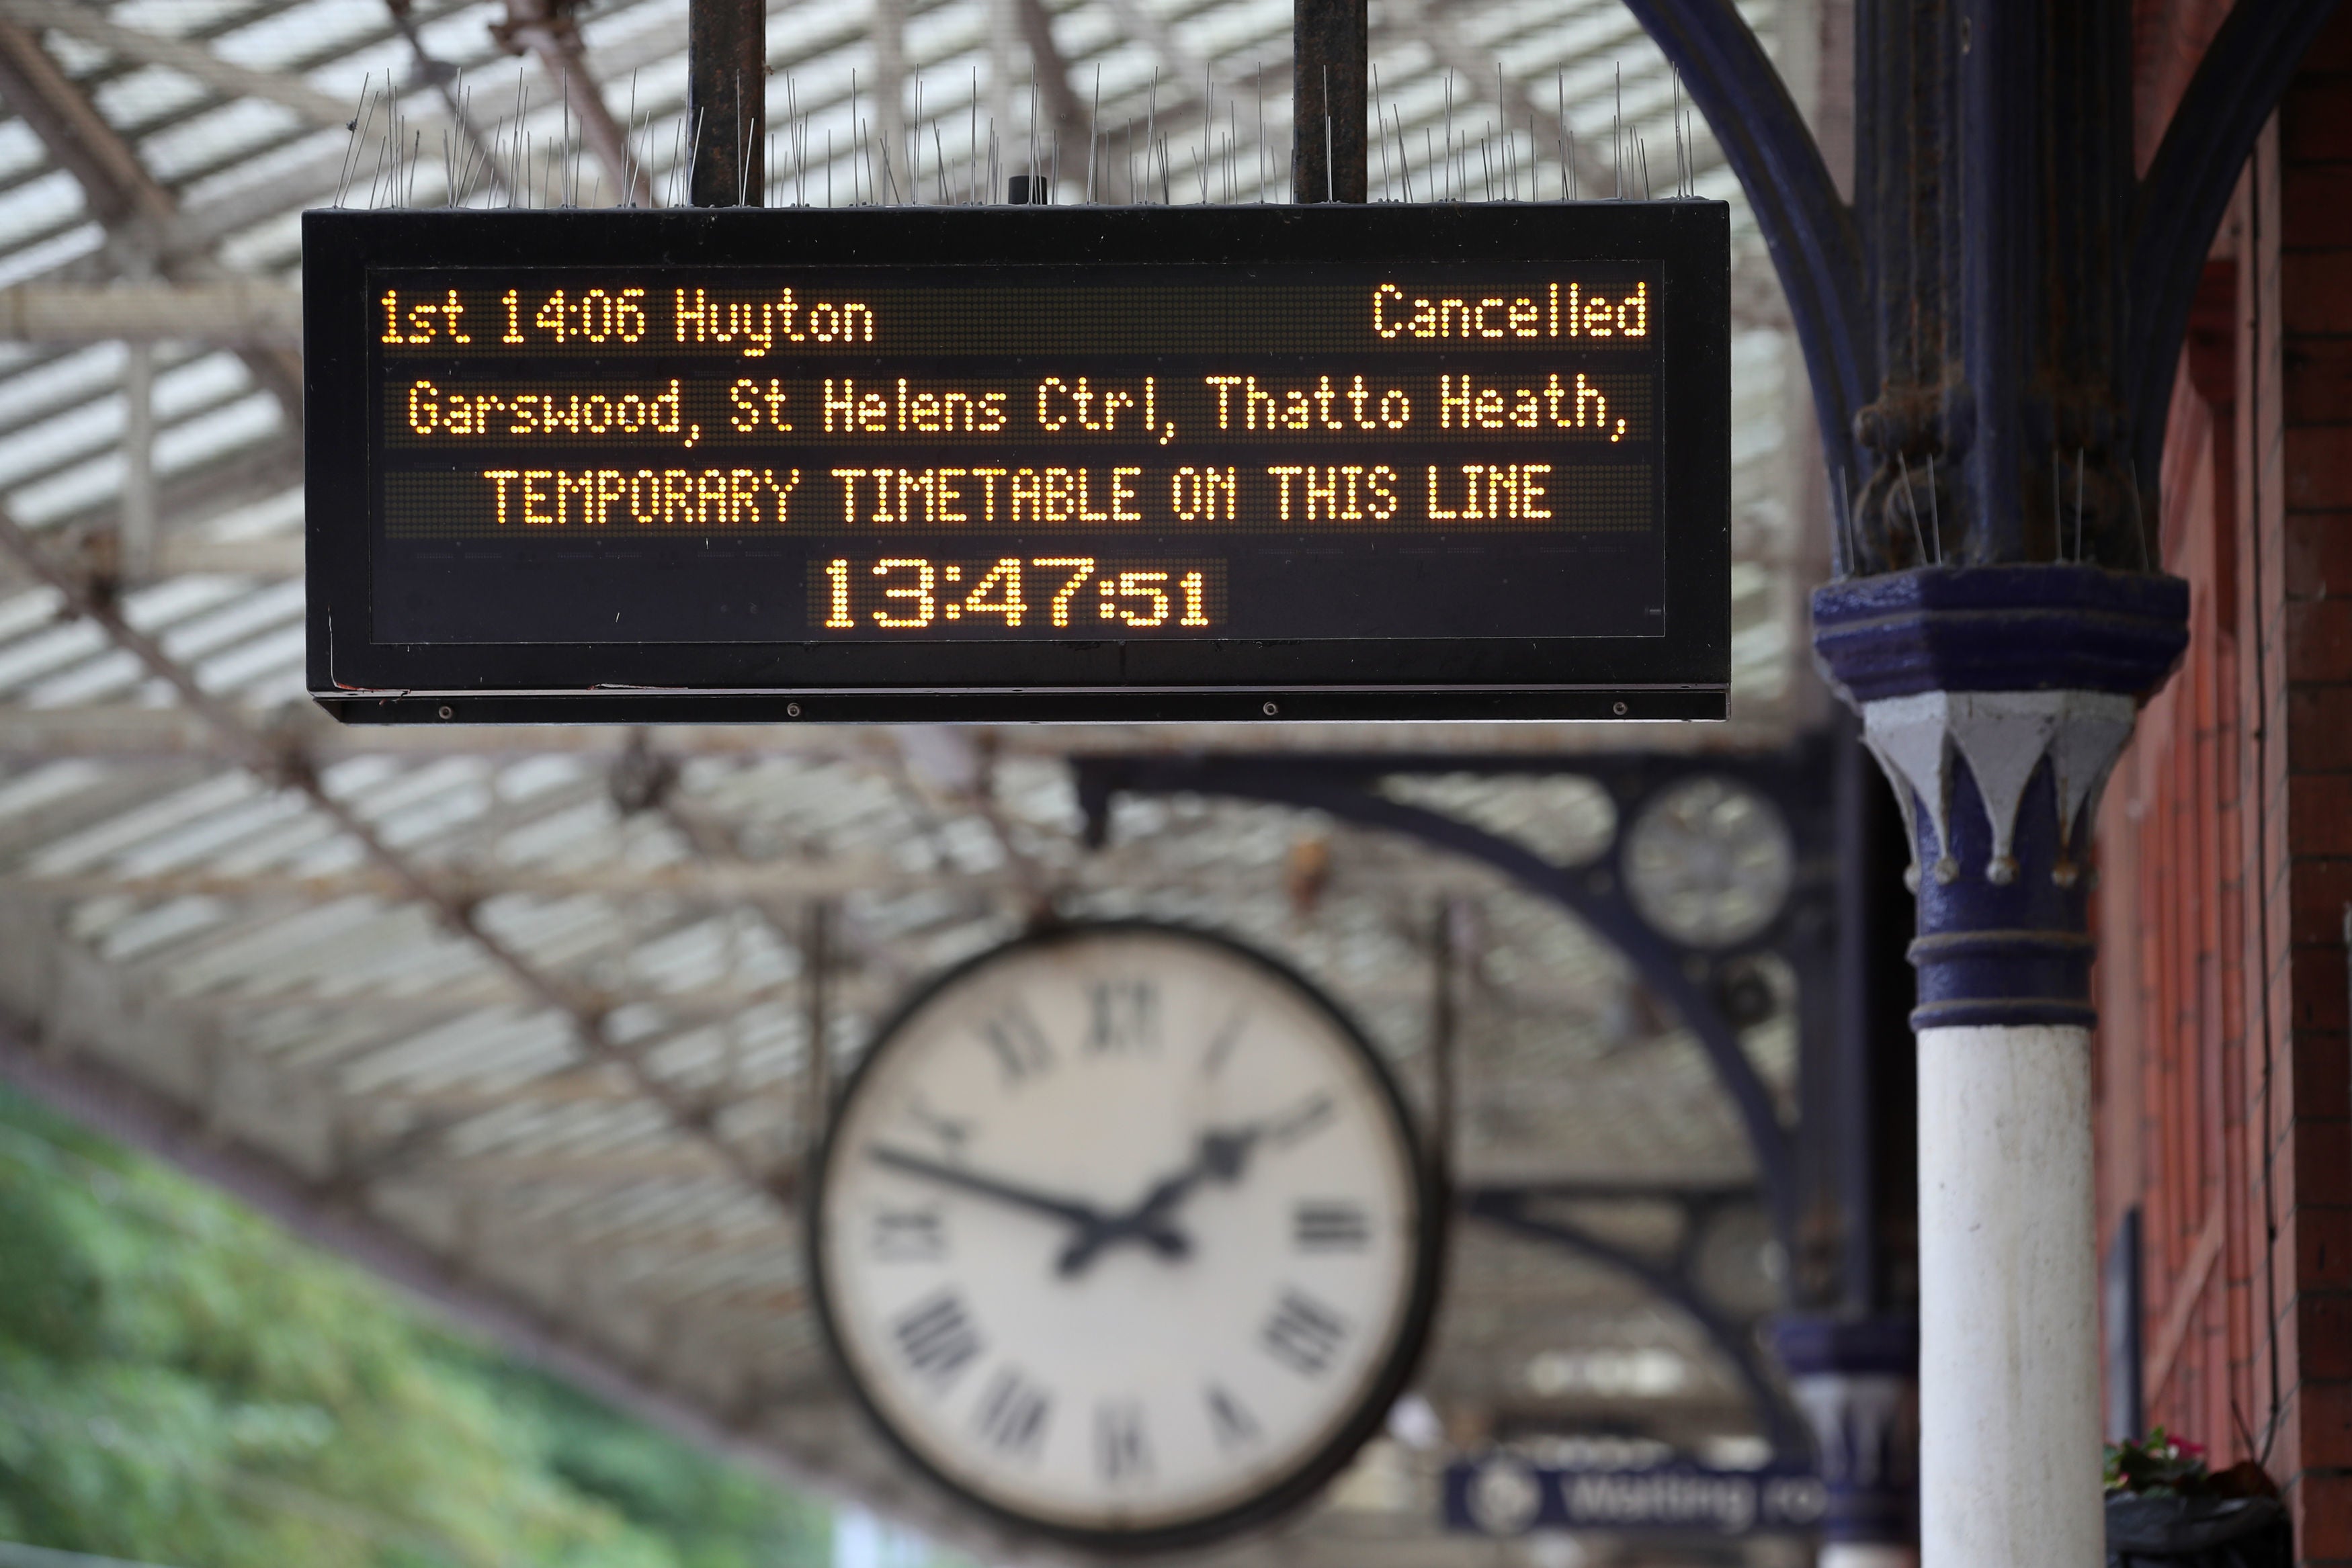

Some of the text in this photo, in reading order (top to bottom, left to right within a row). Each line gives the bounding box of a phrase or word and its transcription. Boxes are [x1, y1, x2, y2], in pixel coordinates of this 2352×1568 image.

[380, 281, 1647, 358] 1st 14:06 Huyton Cancelled
[408, 372, 1626, 449] Garswood, St Helens Ctrl, Thatto Heath,
[482, 463, 1553, 525] TEMPORARY TIMETABLE ON THIS LINE
[824, 556, 1210, 629] 13:47:51
